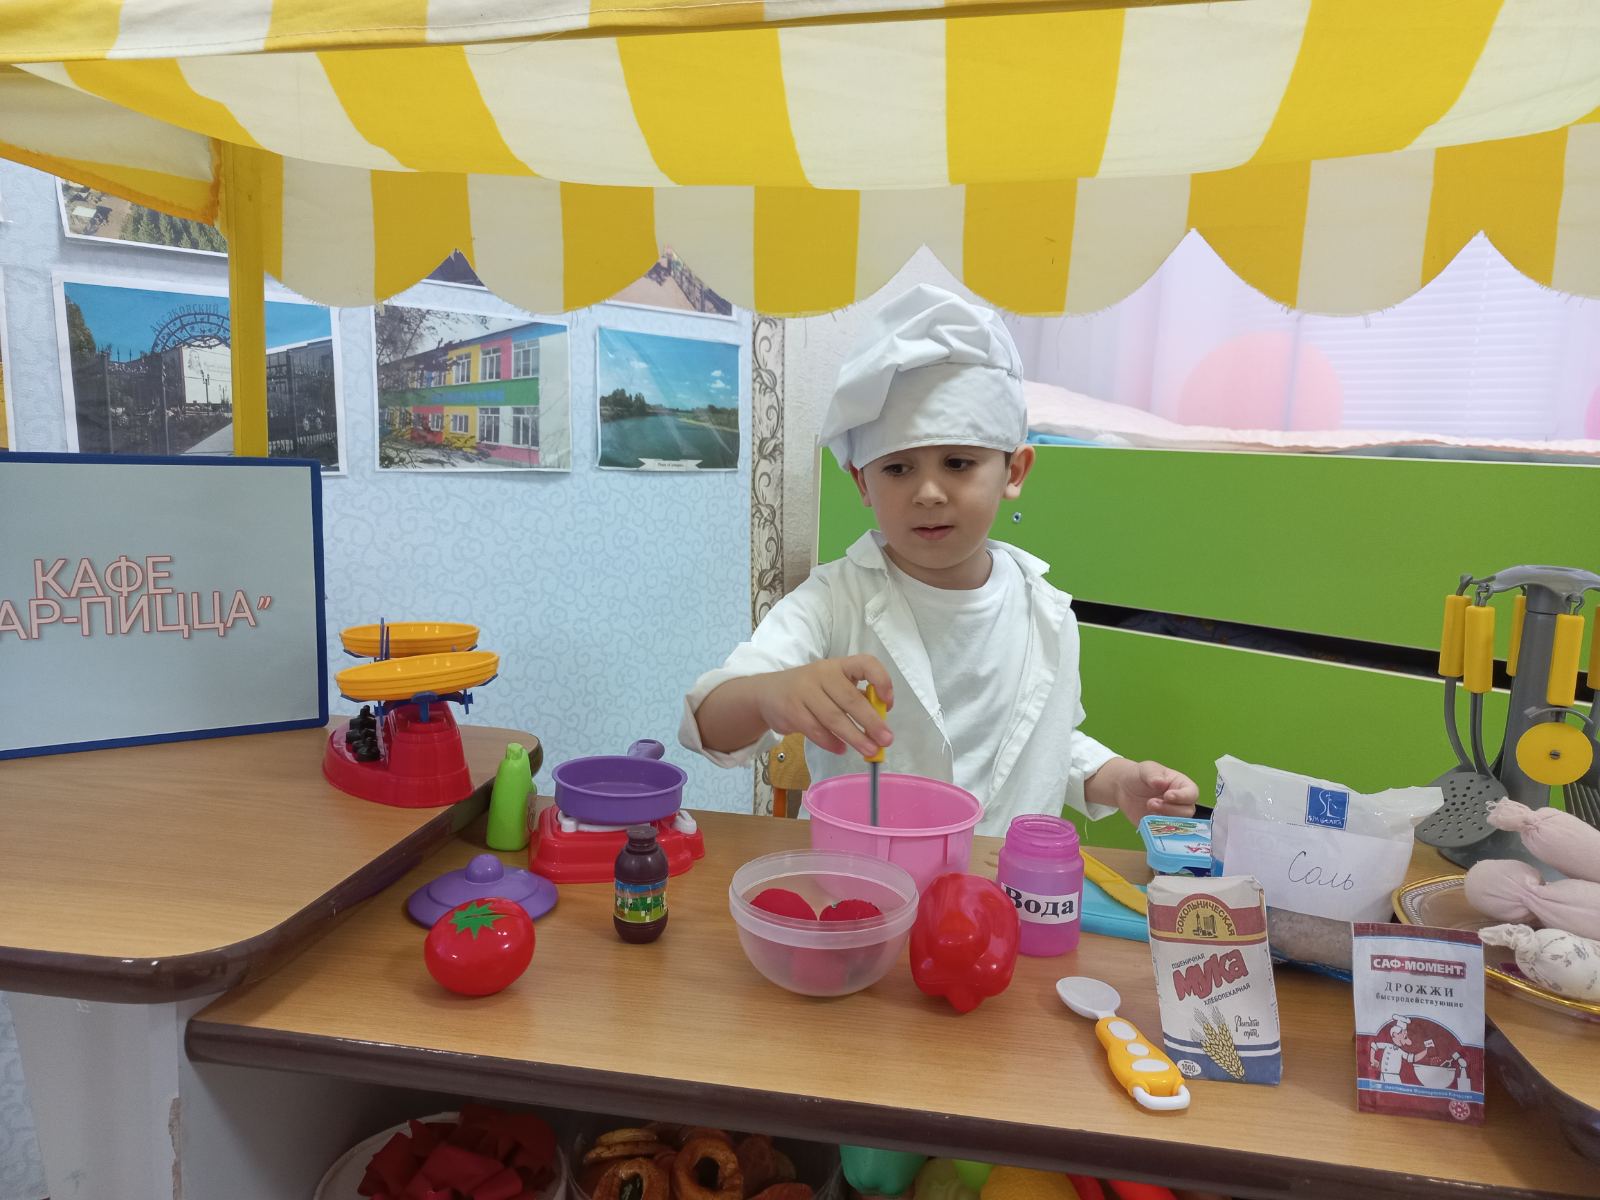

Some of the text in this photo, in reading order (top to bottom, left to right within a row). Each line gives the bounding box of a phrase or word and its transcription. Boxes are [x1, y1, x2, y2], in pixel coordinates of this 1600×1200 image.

[34, 555, 173, 599] КАФЕ
[1288, 850, 1354, 891] Соль
[1176, 900, 1236, 937] СОКОЛЬНИЧЕСКАЯ
[1171, 952, 1206, 970] ПШЕНИЧНАЯ
[1203, 982, 1251, 1006] ХЛЕБОПЕКАРНАЯ
[1375, 992, 1464, 1009] быстродействующие
[1384, 982, 1454, 998] ДРОЖЖИ
